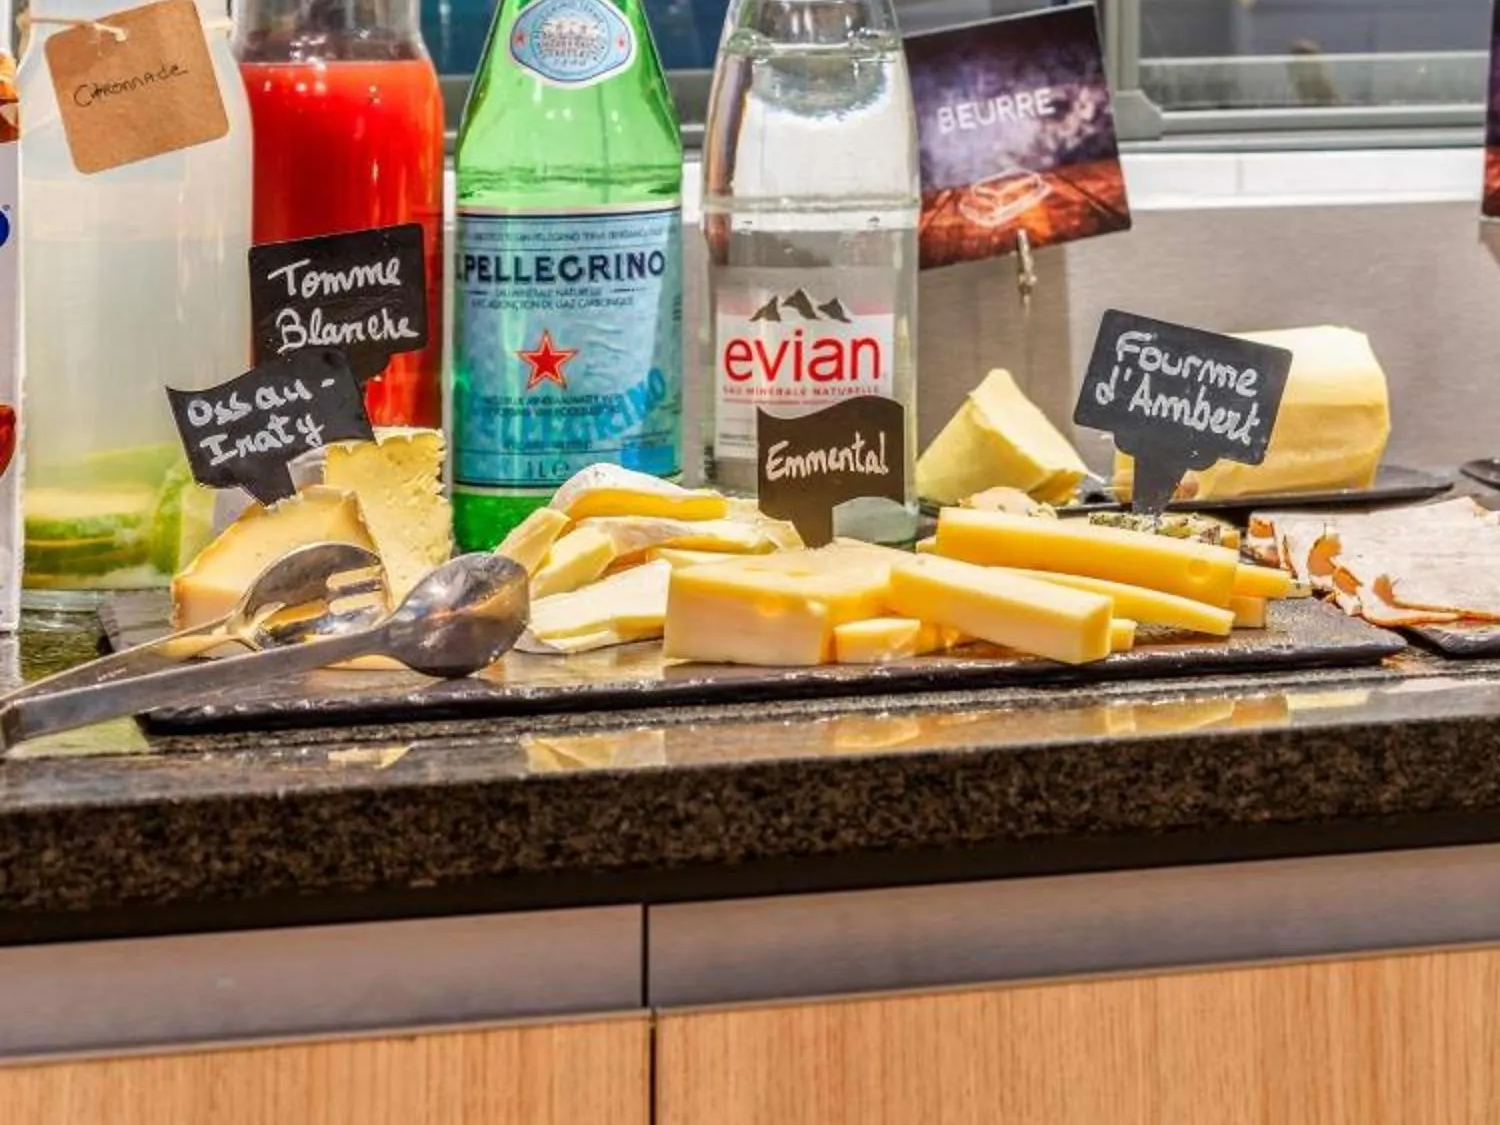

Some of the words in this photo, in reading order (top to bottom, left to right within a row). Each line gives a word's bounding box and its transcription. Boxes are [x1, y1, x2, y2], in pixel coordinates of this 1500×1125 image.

[937, 87, 1057, 135] BEURRE
[267, 256, 402, 299] Tomme
[275, 306, 420, 355] Blanche
[724, 329, 881, 382] evian
[1115, 330, 1258, 398] Fourme
[1095, 364, 1261, 447] d'Ambert
[199, 412, 326, 466] Iraty
[765, 430, 890, 482] Emmental
